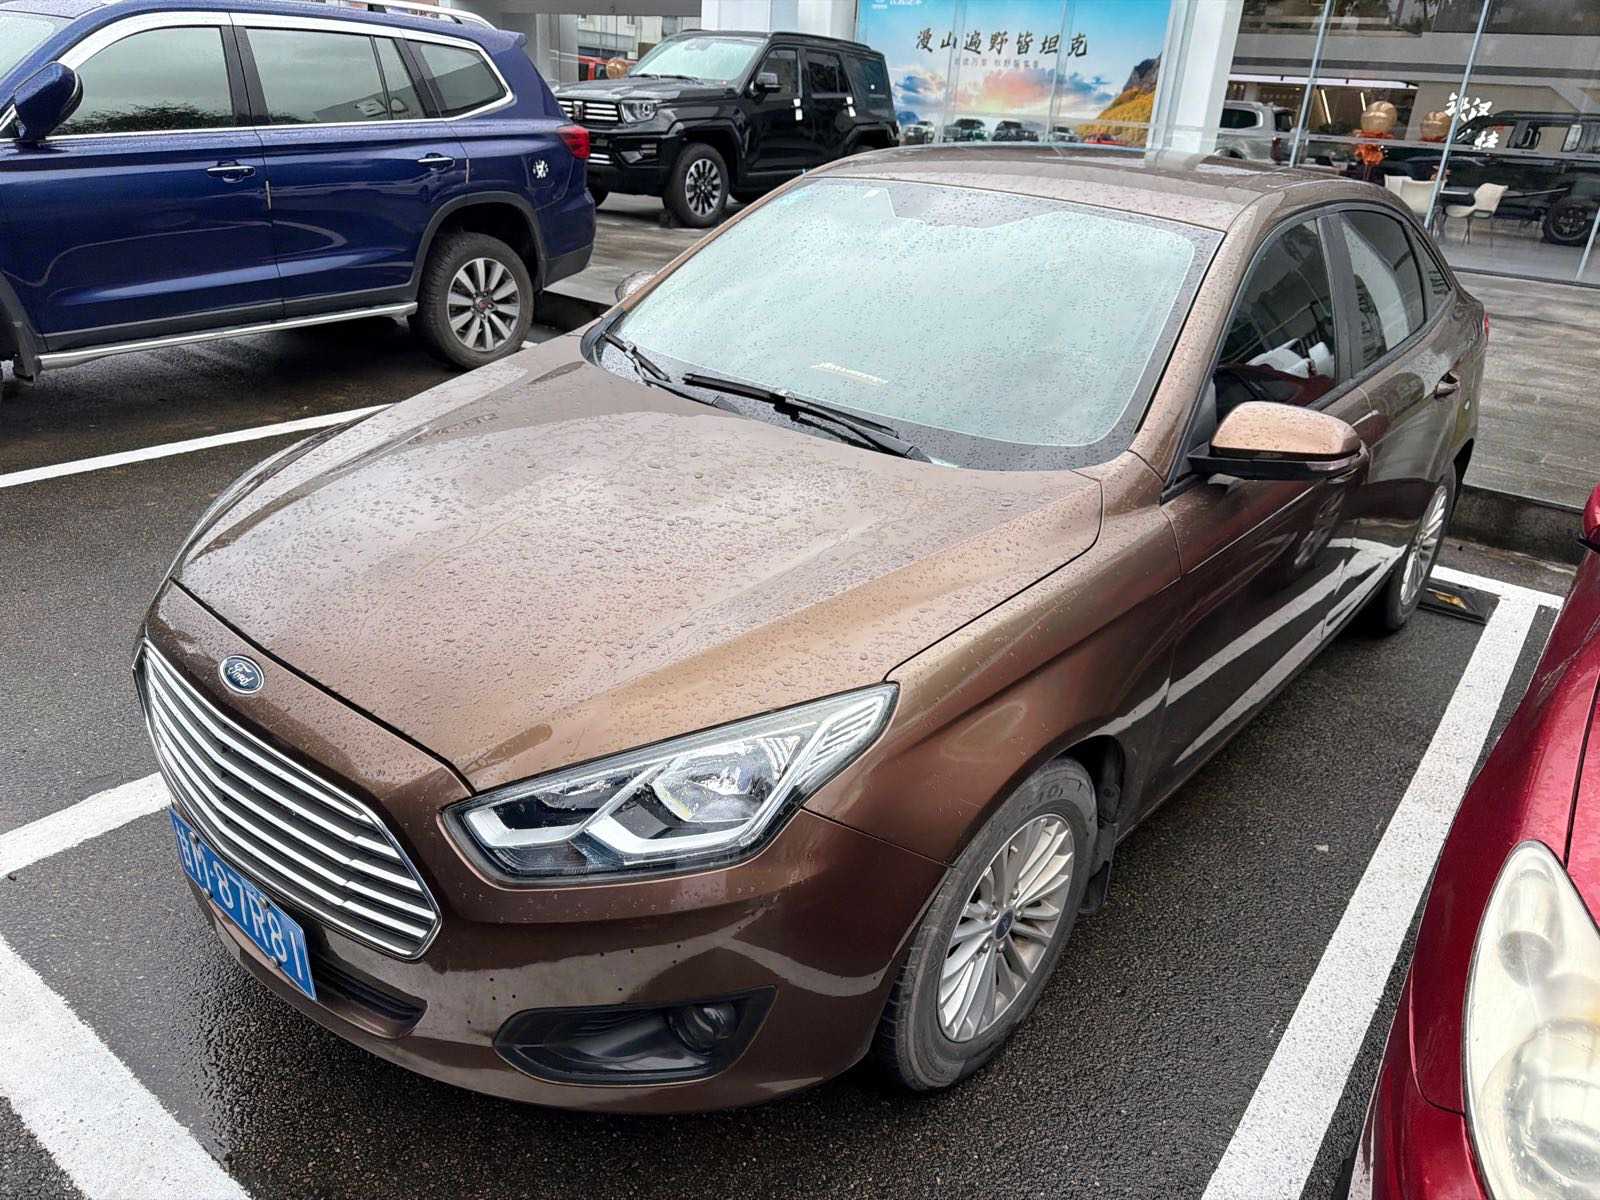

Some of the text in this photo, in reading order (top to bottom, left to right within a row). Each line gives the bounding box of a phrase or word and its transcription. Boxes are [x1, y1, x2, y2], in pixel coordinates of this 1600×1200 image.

[915, 27, 1088, 57] 漫山遍野皆坦克
[227, 663, 255, 687] Ford
